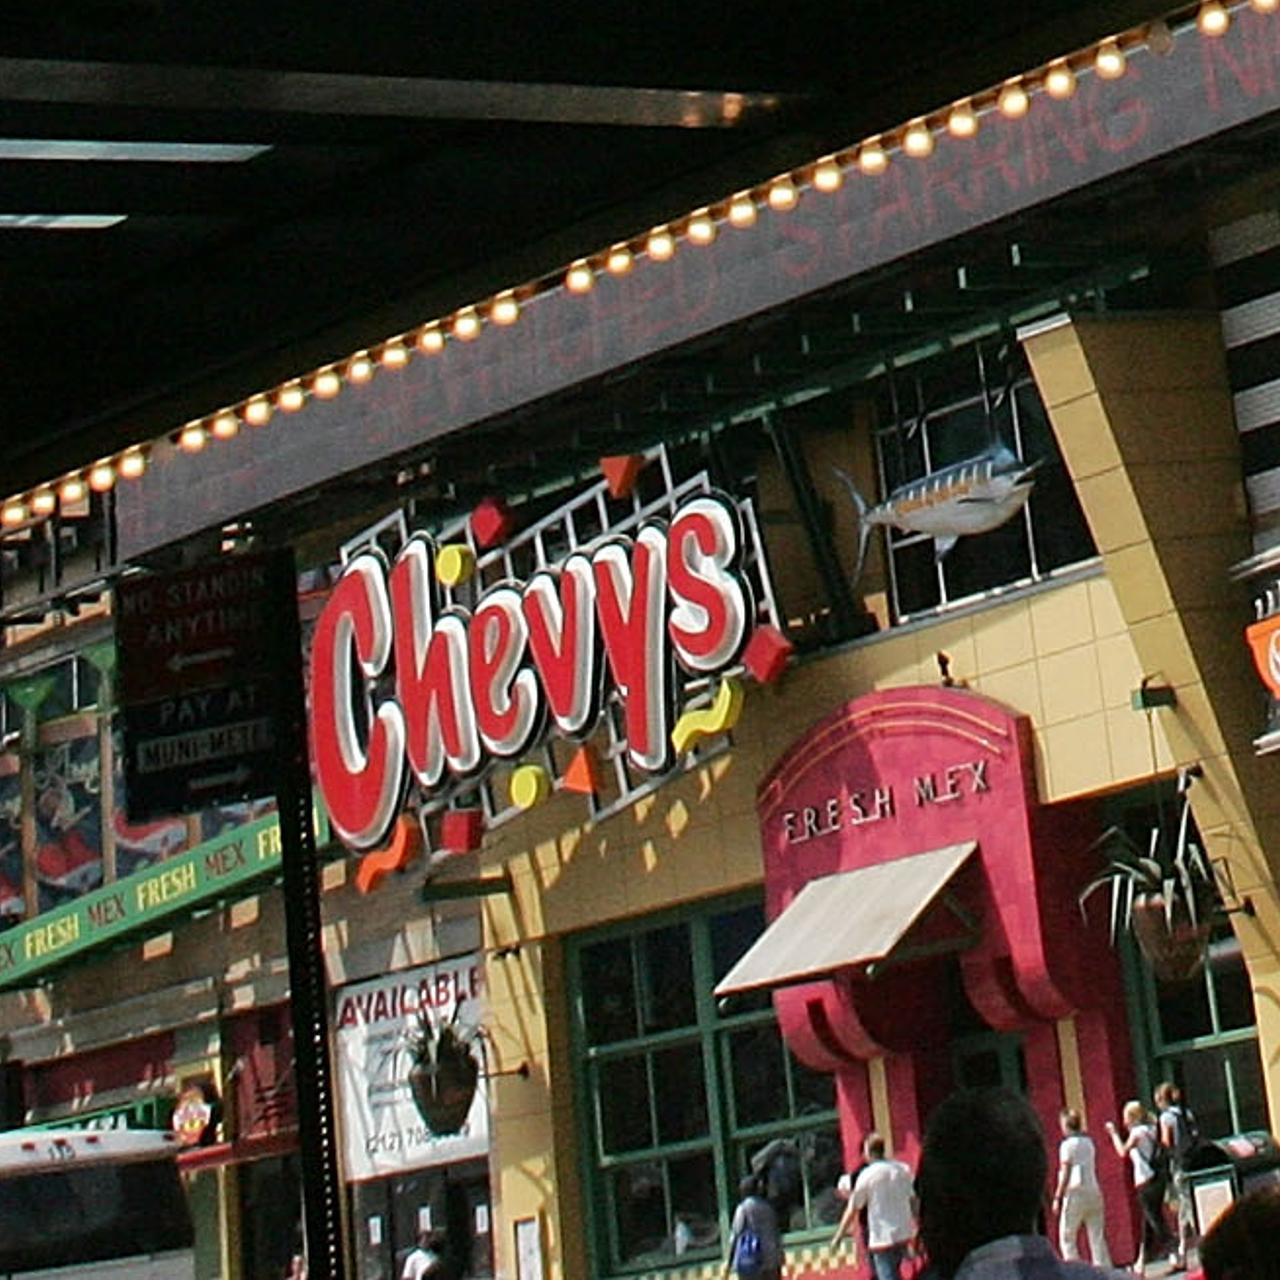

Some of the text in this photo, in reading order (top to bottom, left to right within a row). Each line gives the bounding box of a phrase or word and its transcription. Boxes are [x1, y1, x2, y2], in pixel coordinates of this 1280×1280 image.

[310, 486, 753, 848] Chevys
[782, 758, 991, 844] FRESH MEX
[24, 913, 80, 960] FRESH
[87, 891, 127, 929] MEX
[136, 861, 197, 912] FRESH
[204, 840, 247, 881] MEX
